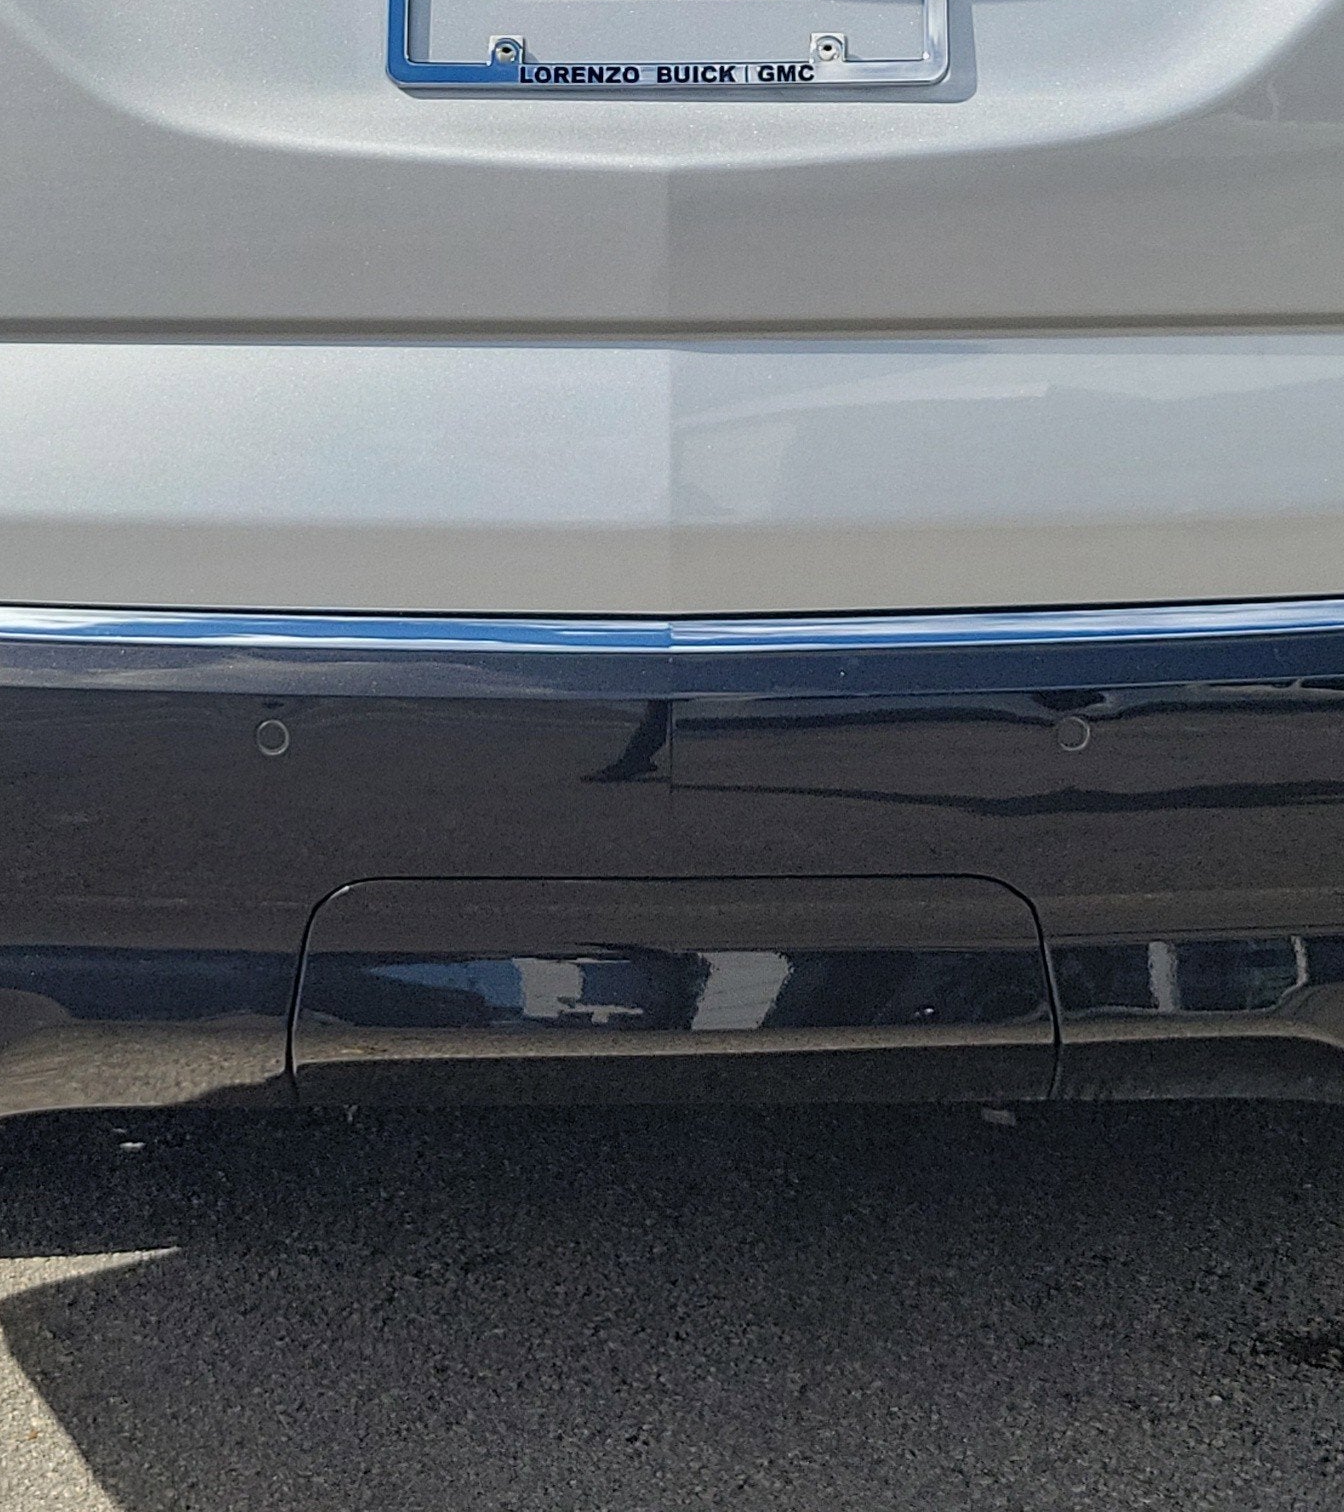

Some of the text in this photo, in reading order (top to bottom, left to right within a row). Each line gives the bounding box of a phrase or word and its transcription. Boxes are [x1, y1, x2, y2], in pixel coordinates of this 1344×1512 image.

[519, 64, 815, 84] LORENZO BUICK GMC
